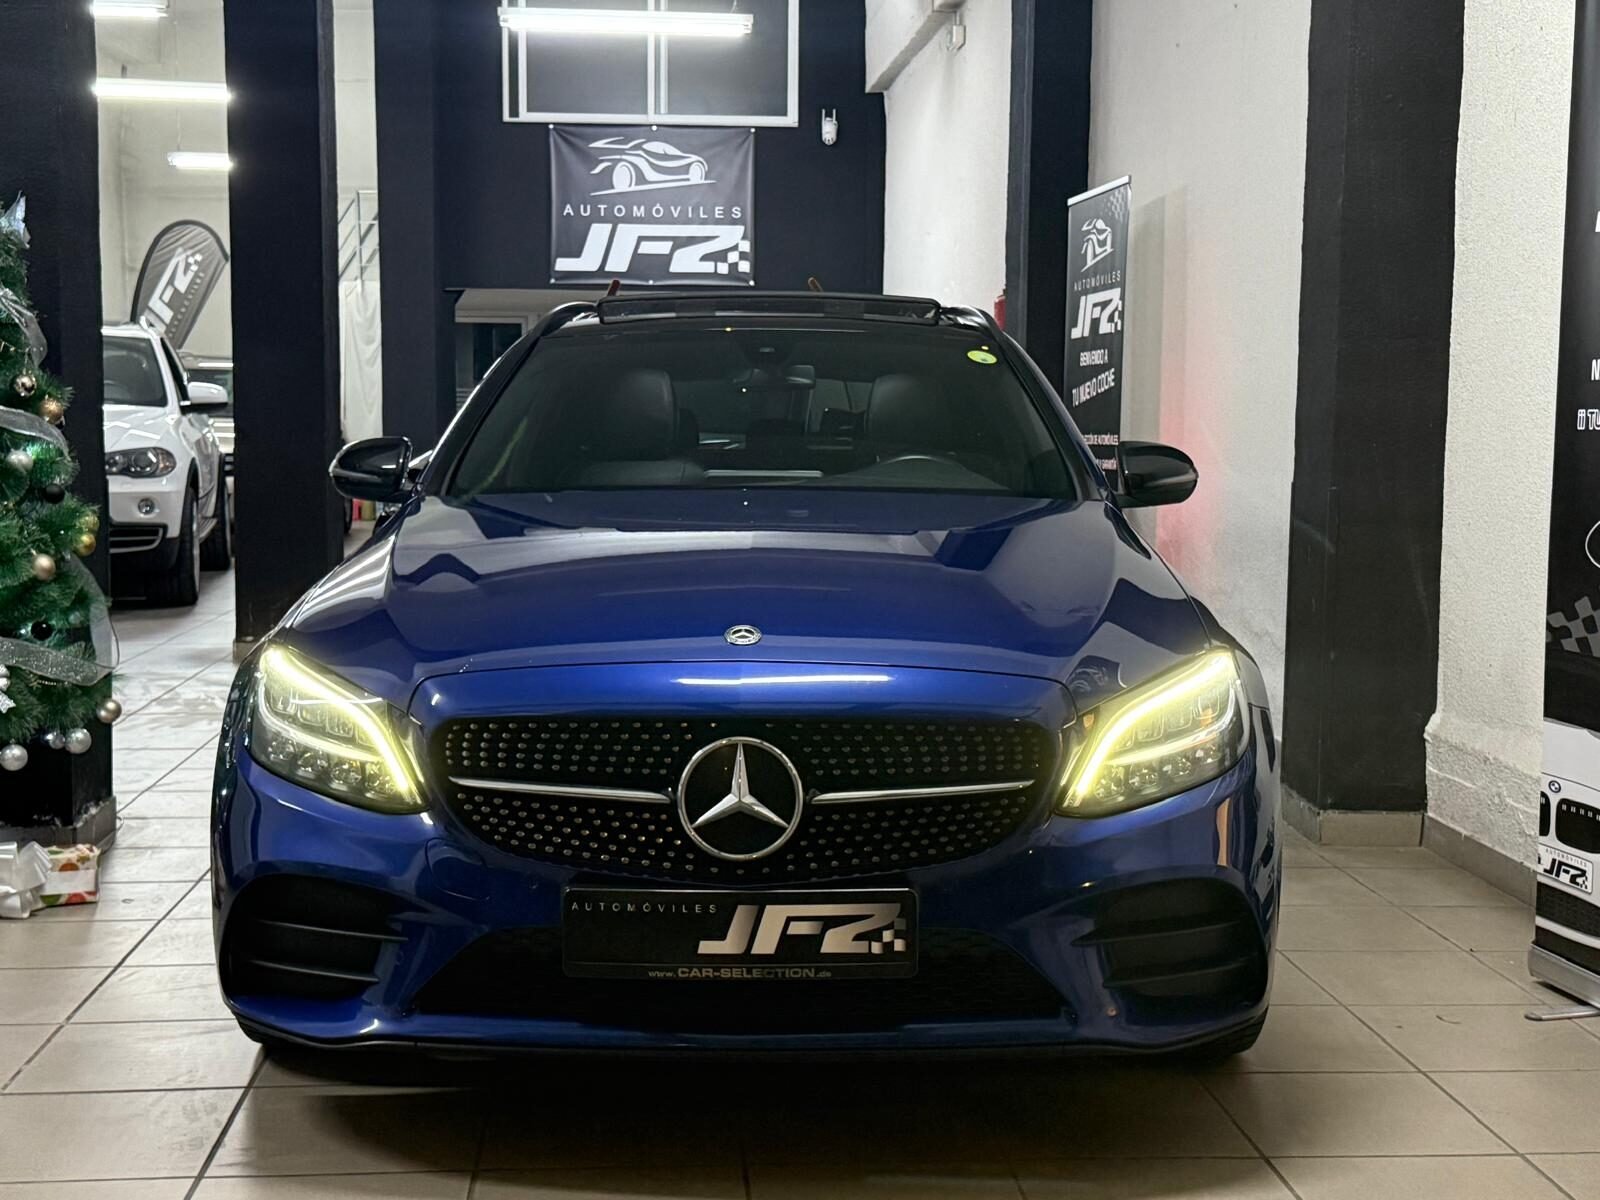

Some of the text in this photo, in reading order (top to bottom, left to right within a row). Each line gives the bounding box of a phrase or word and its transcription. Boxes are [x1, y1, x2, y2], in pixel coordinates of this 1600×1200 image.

[563, 203, 742, 219] AUTOMÓVILES
[554, 223, 749, 273] JFZ
[1073, 270, 1121, 291] AUTOMÓVILES
[1070, 287, 1122, 340] JFZ
[1097, 367, 1116, 394] COCHE
[1543, 857, 1588, 890] JFZ
[571, 902, 717, 913] AUTOMÓVILES
[697, 903, 906, 954] JFZ
